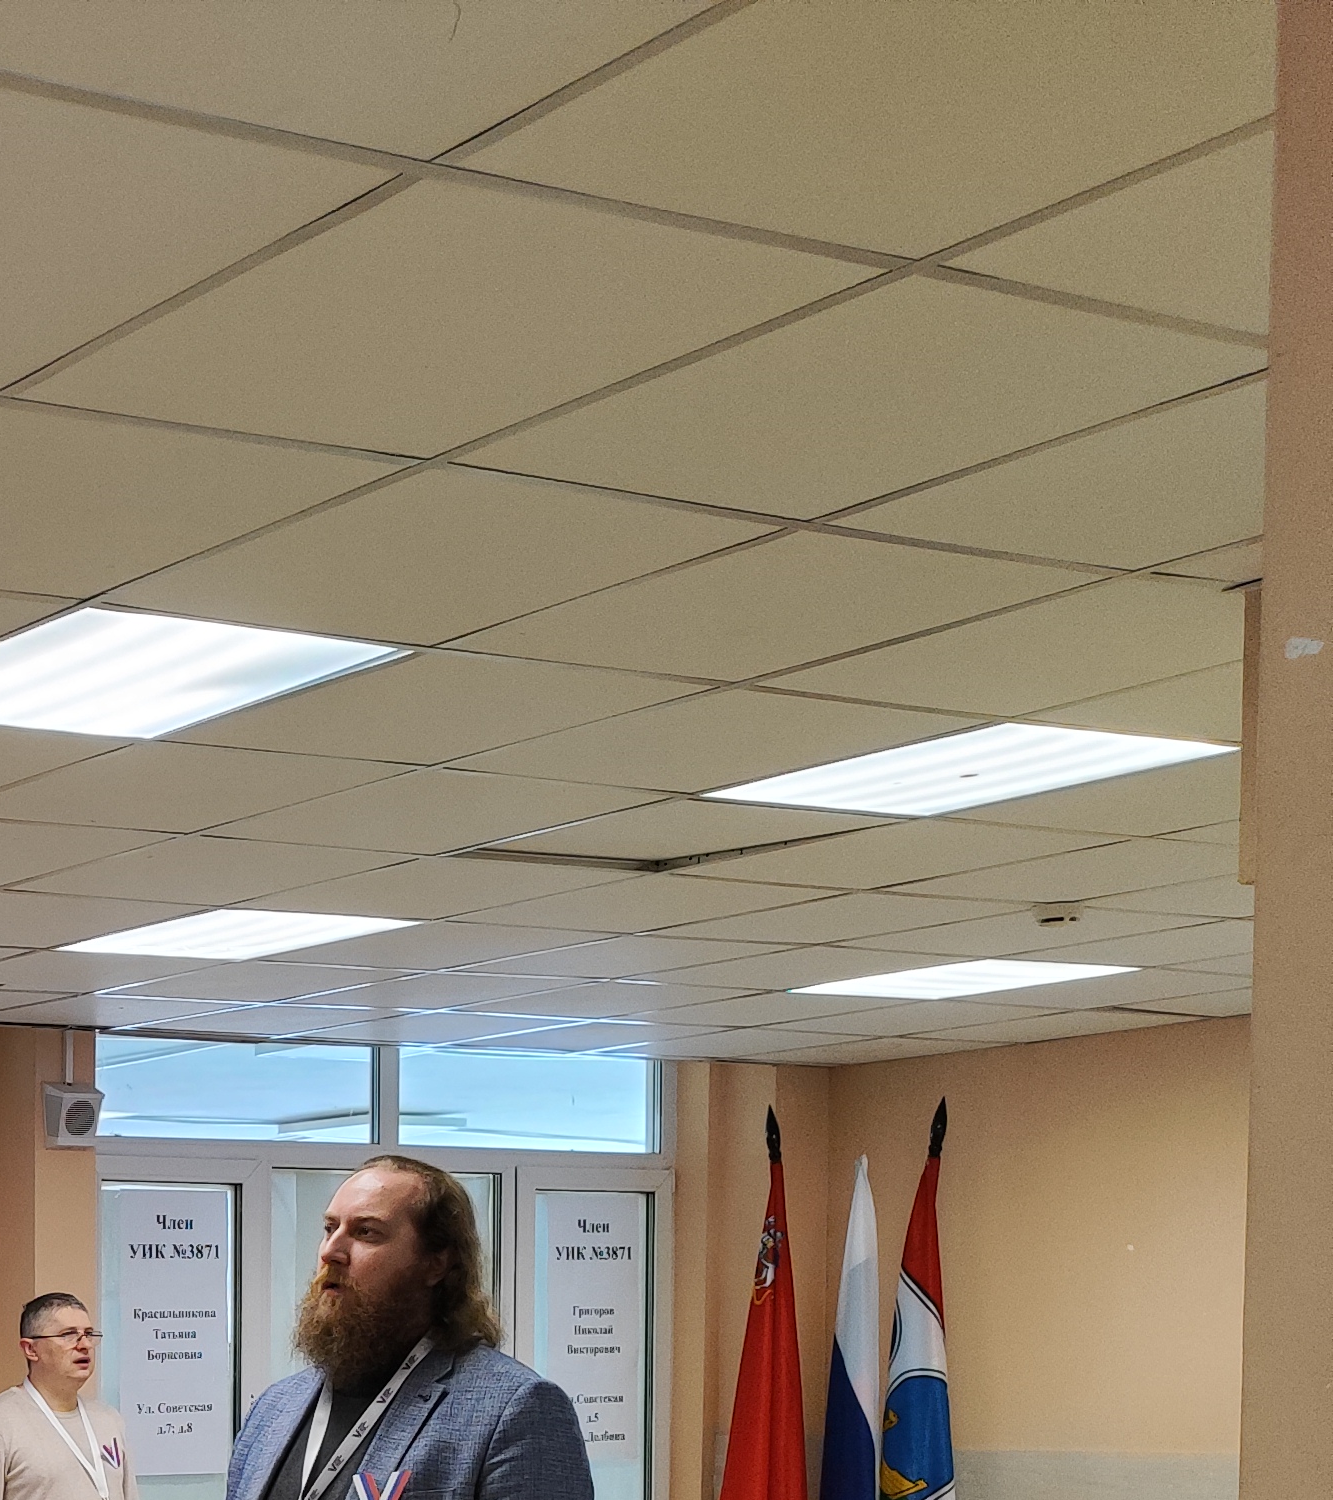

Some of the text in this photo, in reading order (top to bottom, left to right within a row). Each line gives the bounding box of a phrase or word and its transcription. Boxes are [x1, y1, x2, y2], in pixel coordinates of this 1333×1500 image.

[156, 1214, 194, 1230] Член
[577, 1218, 610, 1234] Член
[128, 1243, 220, 1260] УИК №3871
[555, 1246, 632, 1261] УИК №3871
[133, 1308, 217, 1322] Красильникова
[153, 1328, 197, 1340] Татьяна
[573, 1325, 614, 1336] Николай
[147, 1349, 203, 1363] Борисовна
[567, 1344, 621, 1356] Викторович
[136, 1402, 213, 1415] Ул. Советская
